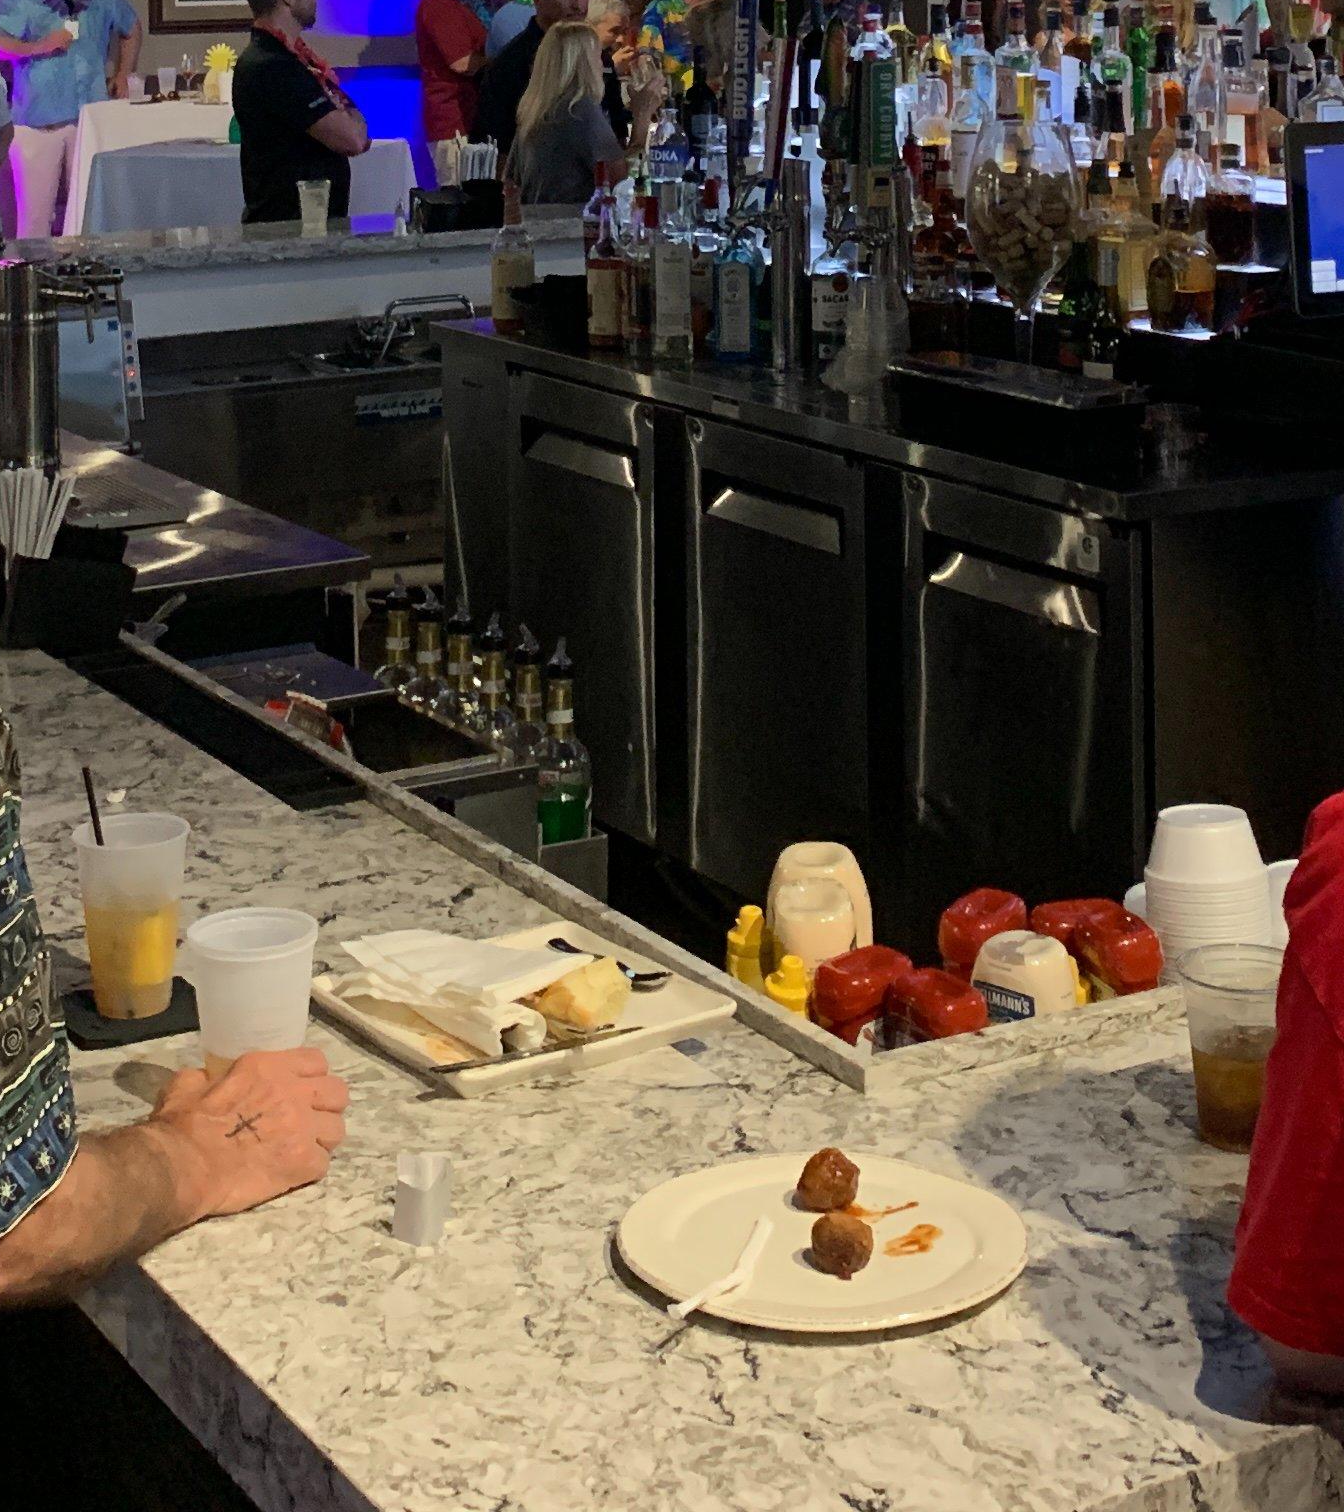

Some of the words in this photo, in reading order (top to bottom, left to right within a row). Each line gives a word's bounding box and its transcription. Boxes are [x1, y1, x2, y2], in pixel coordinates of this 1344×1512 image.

[734, 17, 751, 73] LIGHT
[733, 75, 749, 120] BUD
[651, 149, 679, 163] EDKA
[985, 989, 1031, 1016] LMANN'S
